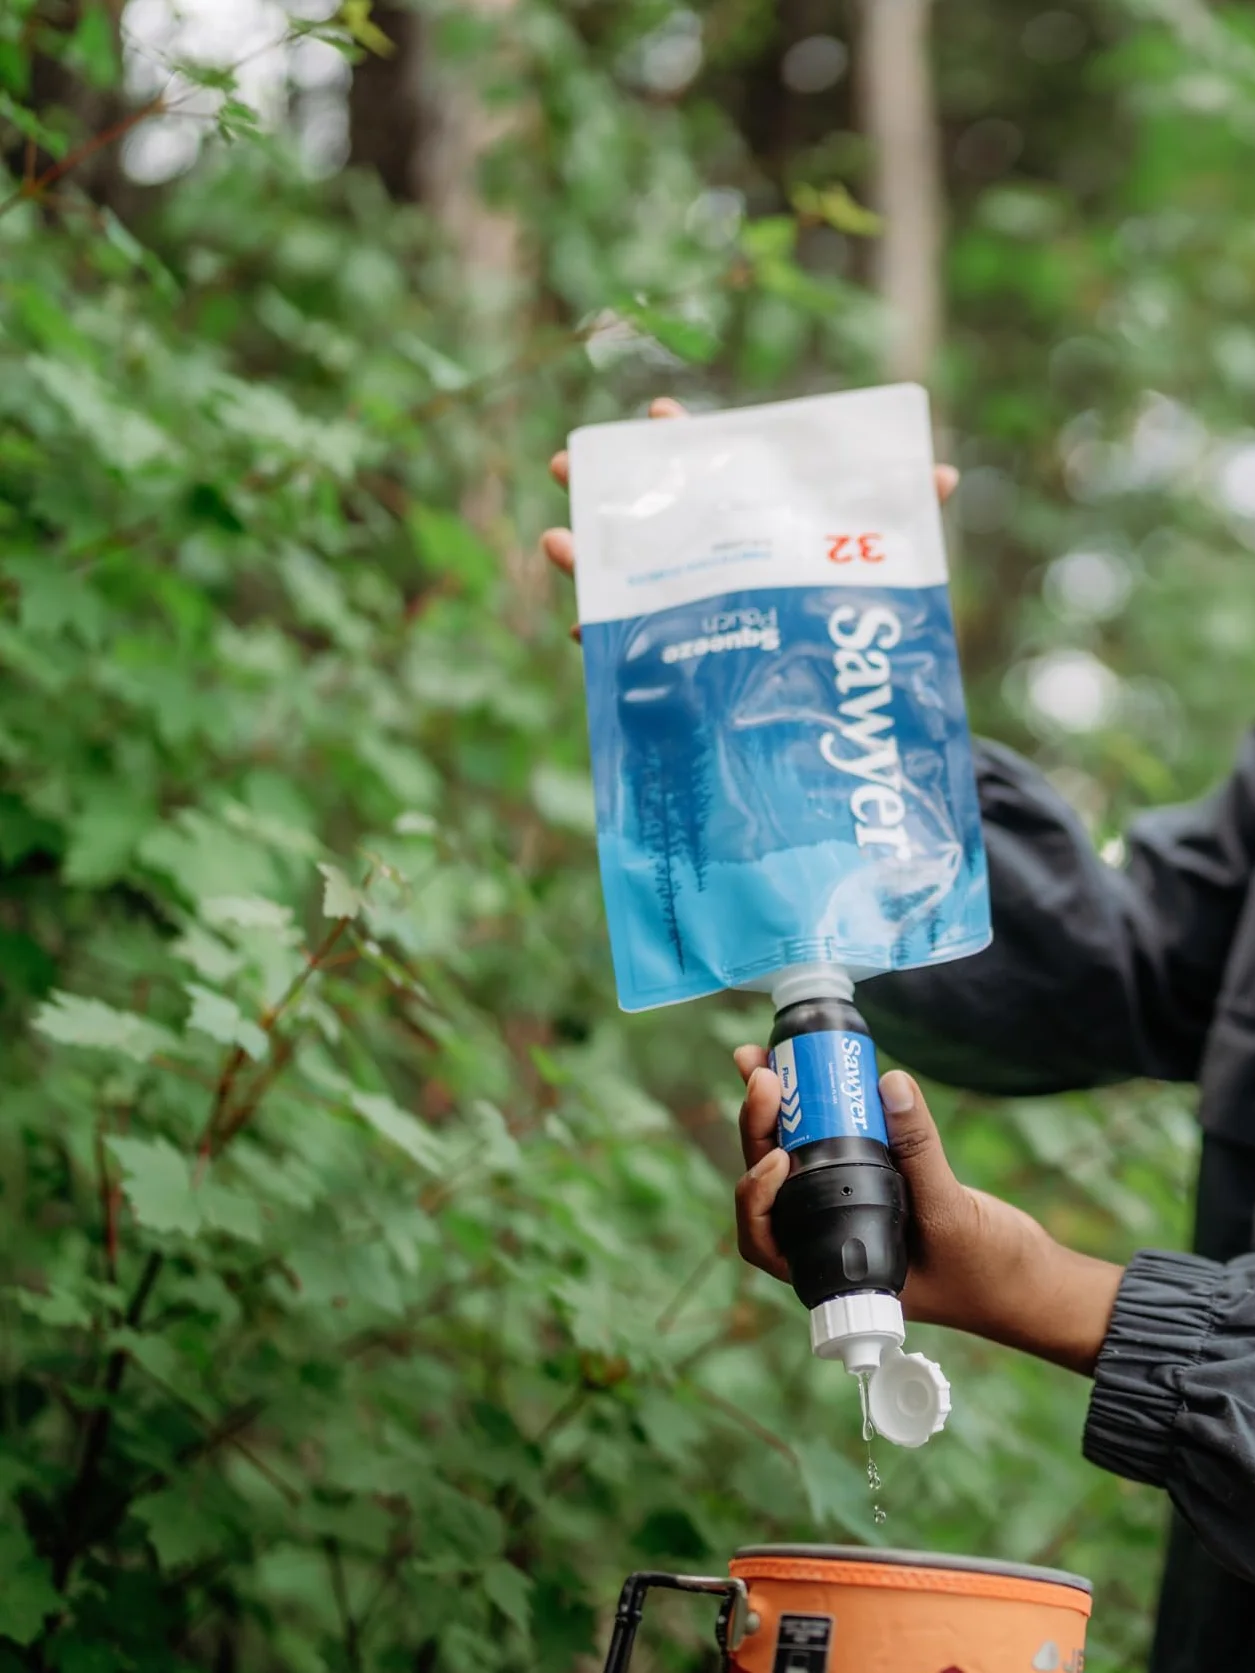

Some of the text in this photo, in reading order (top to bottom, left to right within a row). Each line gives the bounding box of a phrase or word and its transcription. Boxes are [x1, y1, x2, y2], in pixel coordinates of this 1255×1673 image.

[824, 532, 886, 564] 32
[701, 606, 779, 634] Pouch
[661, 627, 781, 665] Squeeze
[820, 606, 912, 861] Sawyer
[841, 1038, 868, 1130] Sawyer
